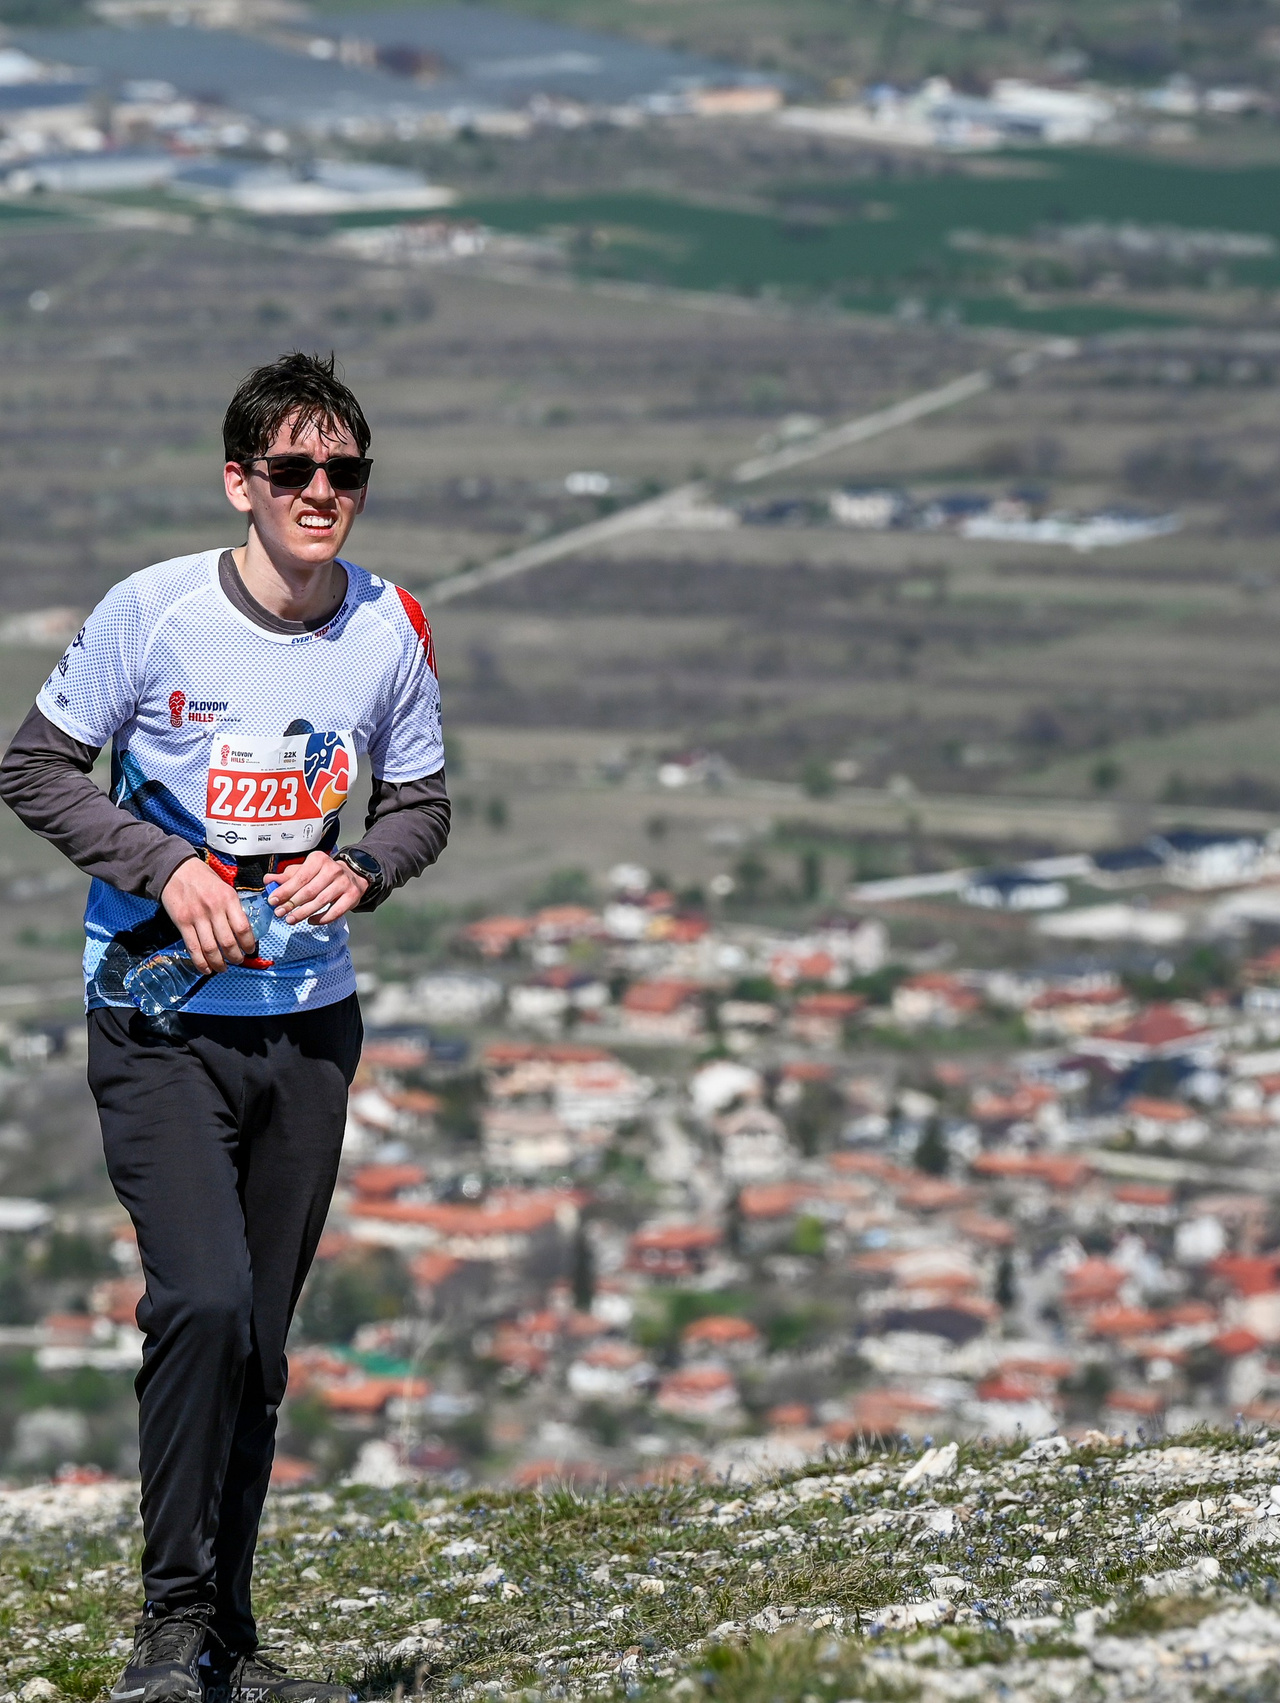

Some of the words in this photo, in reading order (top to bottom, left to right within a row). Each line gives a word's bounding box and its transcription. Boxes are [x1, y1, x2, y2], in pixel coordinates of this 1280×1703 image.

[291, 634, 314, 644] EVERY
[314, 625, 330, 639] STEP
[188, 701, 229, 711] PLOVDIV
[188, 712, 214, 722] HILLS
[283, 751, 297, 759] 22K
[210, 775, 299, 818] 2223
